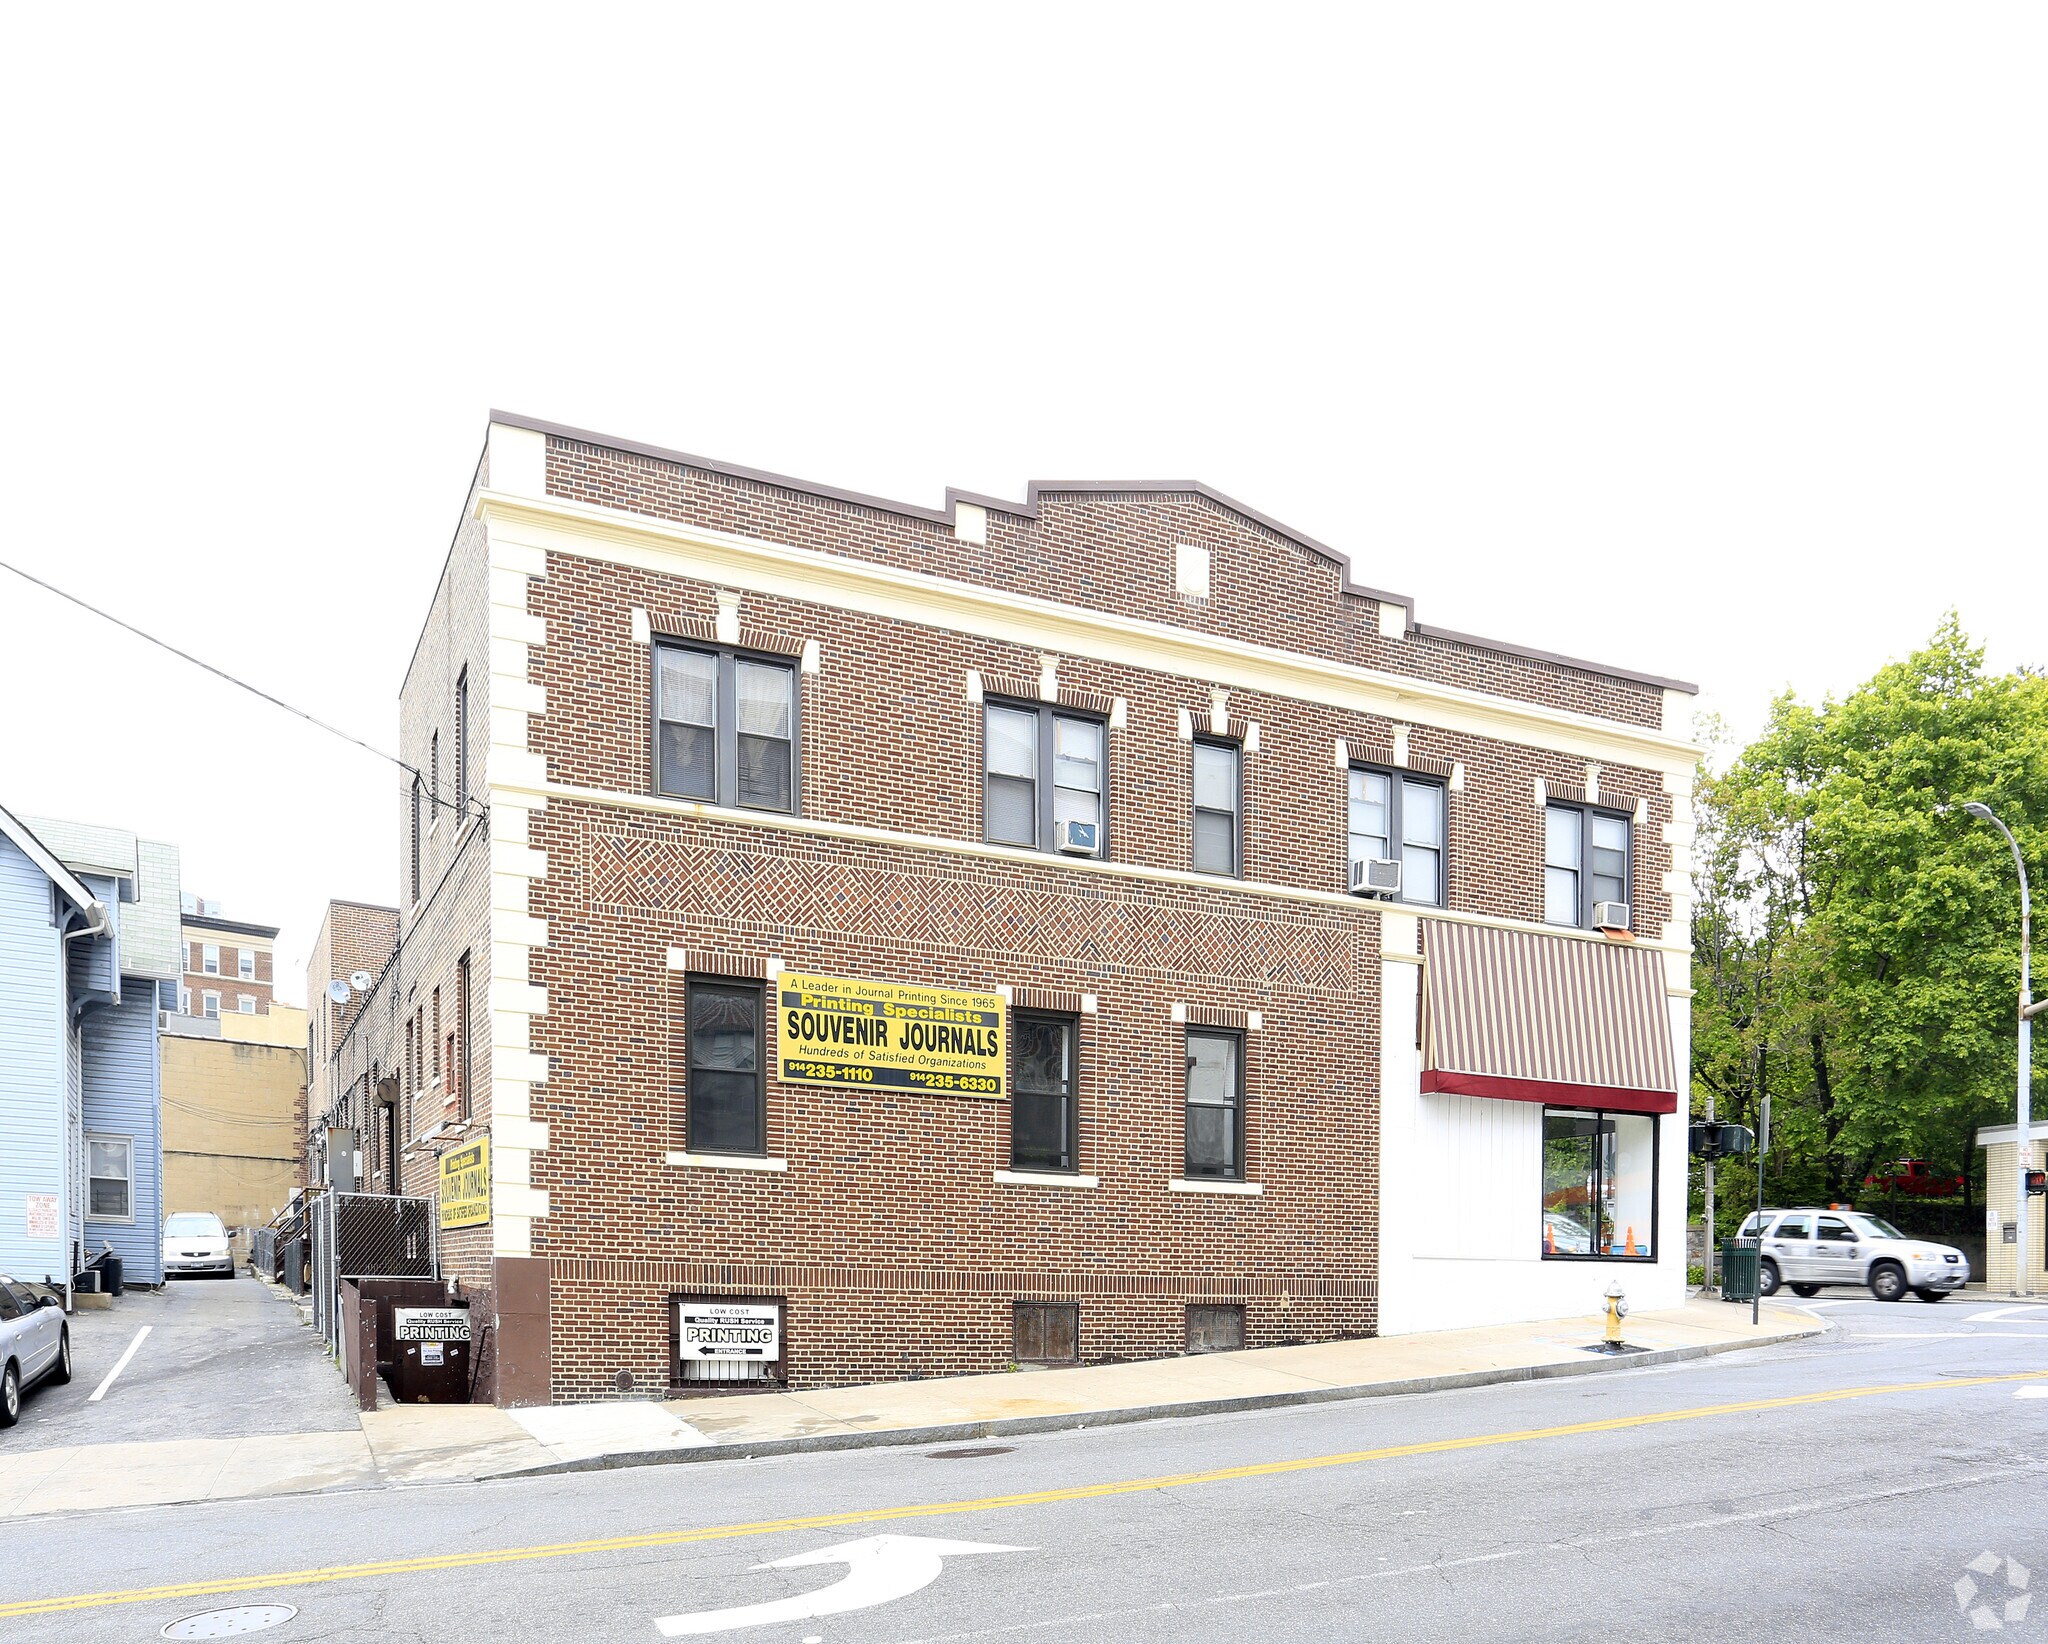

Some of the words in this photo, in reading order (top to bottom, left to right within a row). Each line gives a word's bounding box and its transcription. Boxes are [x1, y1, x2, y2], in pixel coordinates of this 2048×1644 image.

[790, 978, 798, 989] A
[802, 979, 838, 993] Leader
[842, 984, 851, 994] in
[855, 985, 893, 999] Journal
[898, 990, 936, 1005] Printing
[940, 994, 968, 1007] Since
[972, 997, 996, 1008] 1965
[801, 993, 874, 1017] Printing
[883, 1003, 983, 1024] Specialists
[787, 1010, 888, 1048] SOUVENIR
[899, 1022, 998, 1058] JOURNALS
[799, 1044, 849, 1059] Hundreds
[853, 1049, 864, 1060] of
[868, 1050, 914, 1064] Satisfied
[918, 1055, 987, 1070] Organizations
[400, 1325, 471, 1340] PRINTING
[686, 1327, 773, 1343] PRINTING
